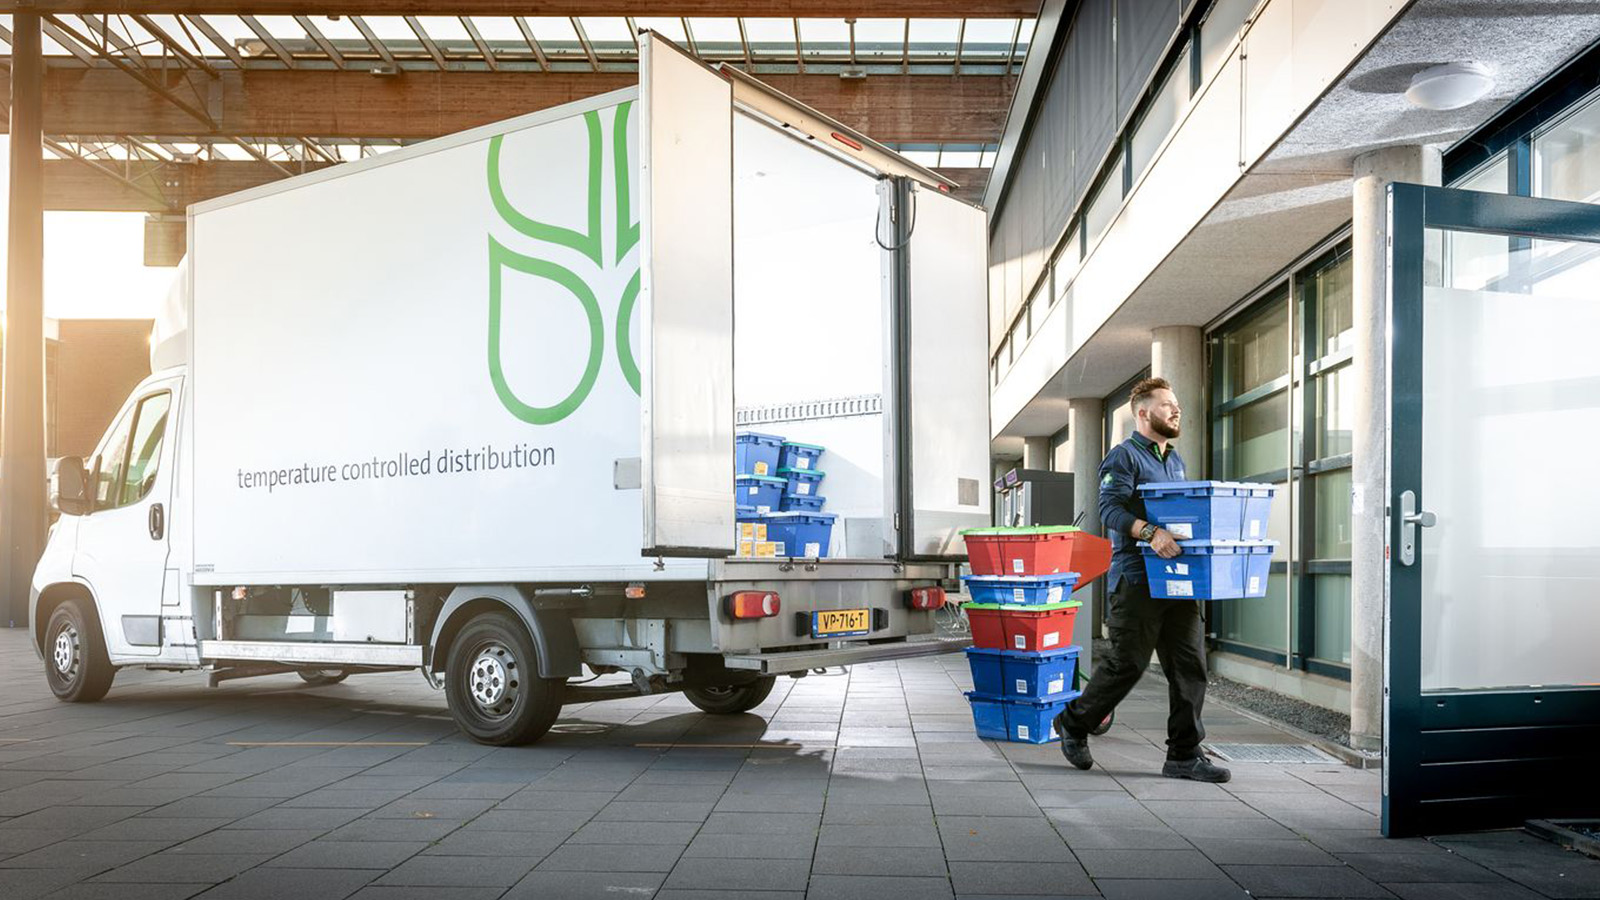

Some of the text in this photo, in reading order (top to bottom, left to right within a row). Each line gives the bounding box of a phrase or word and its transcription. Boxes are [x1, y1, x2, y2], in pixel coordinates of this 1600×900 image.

[237, 443, 555, 493] temperature controlled distribution
[823, 612, 864, 630] VP-716-T
